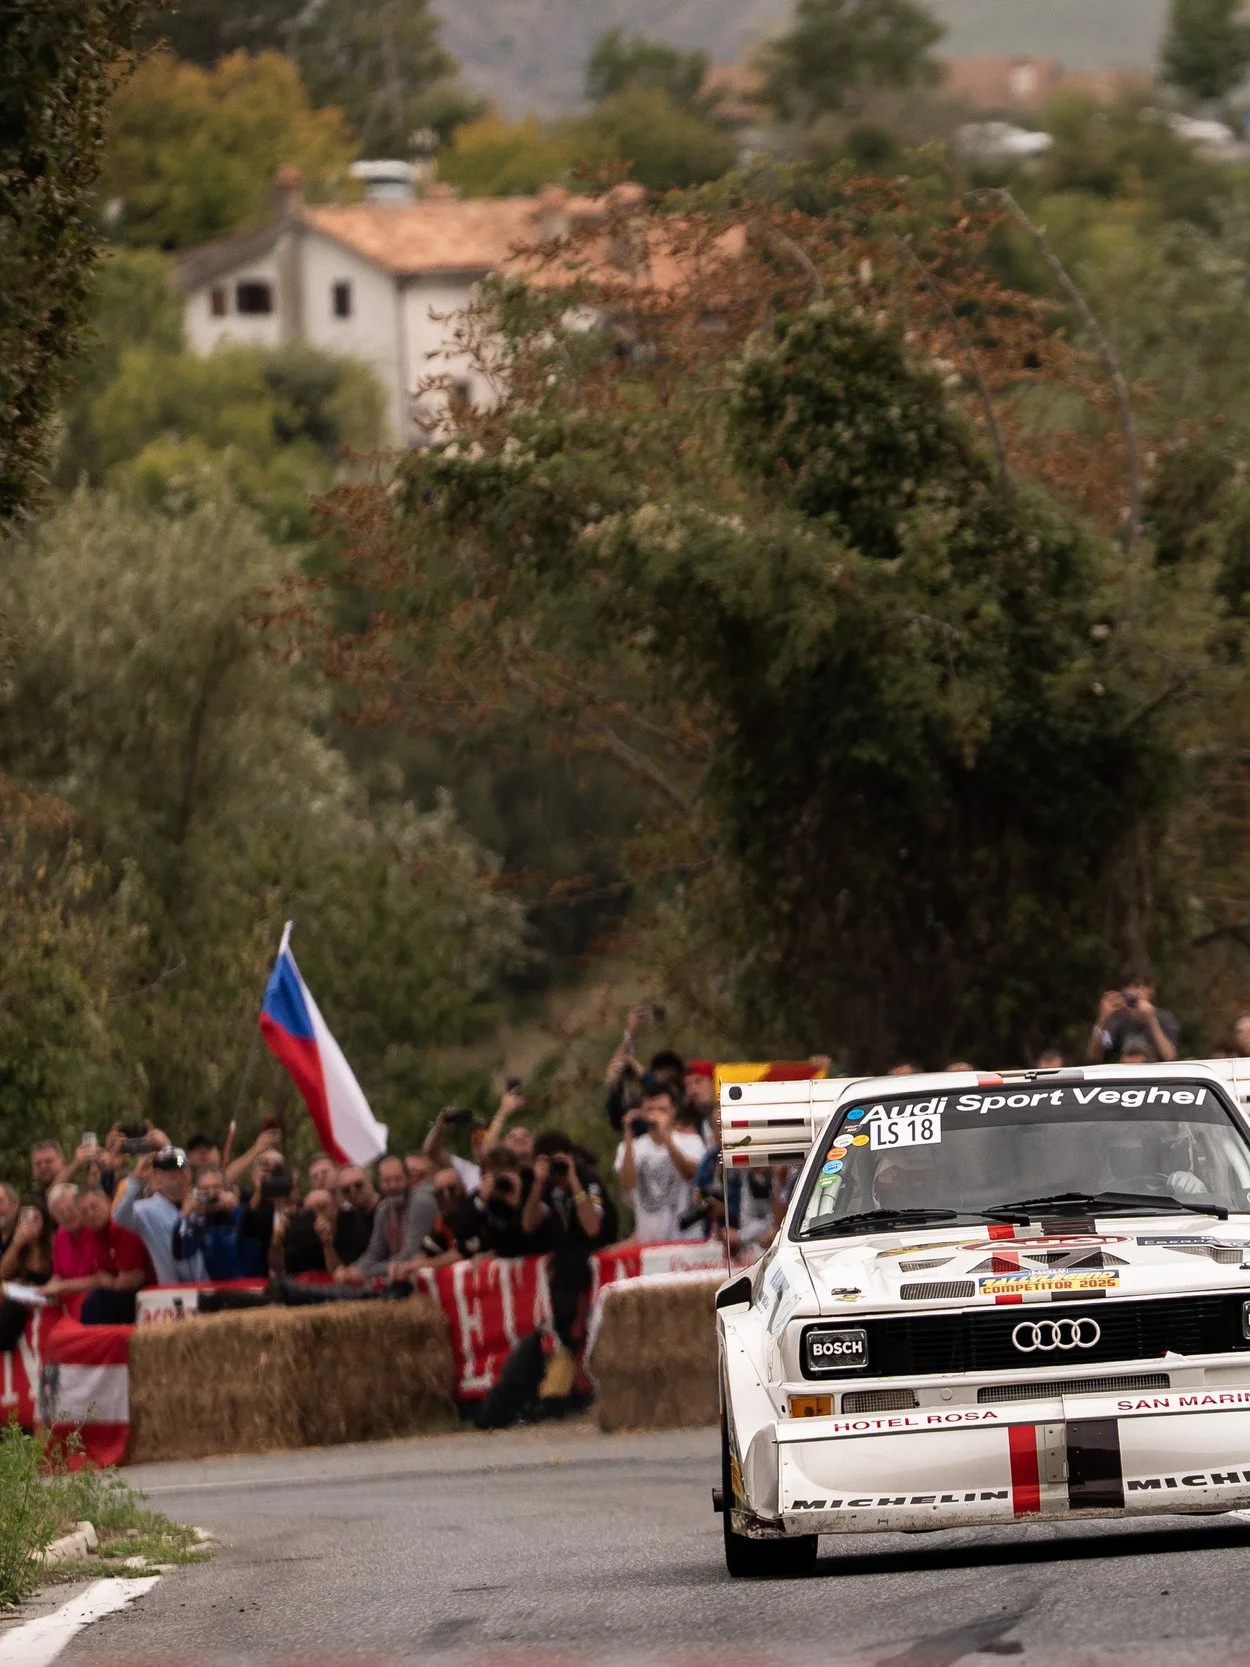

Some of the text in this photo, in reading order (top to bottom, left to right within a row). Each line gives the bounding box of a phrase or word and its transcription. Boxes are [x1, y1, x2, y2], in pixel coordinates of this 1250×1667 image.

[860, 1097, 948, 1125] Audi
[956, 1090, 1064, 1114] Sport
[1073, 1087, 1207, 1107] Veghel
[877, 1122, 899, 1146] LS
[907, 1119, 934, 1141] 18
[983, 1279, 1116, 1295] COMPETITOR 2025
[812, 1341, 863, 1356] BOSCH
[1117, 1398, 1170, 1410] SAN
[834, 1411, 998, 1432] HOTEL ROSA
[791, 1490, 1008, 1510] MICHELIN
